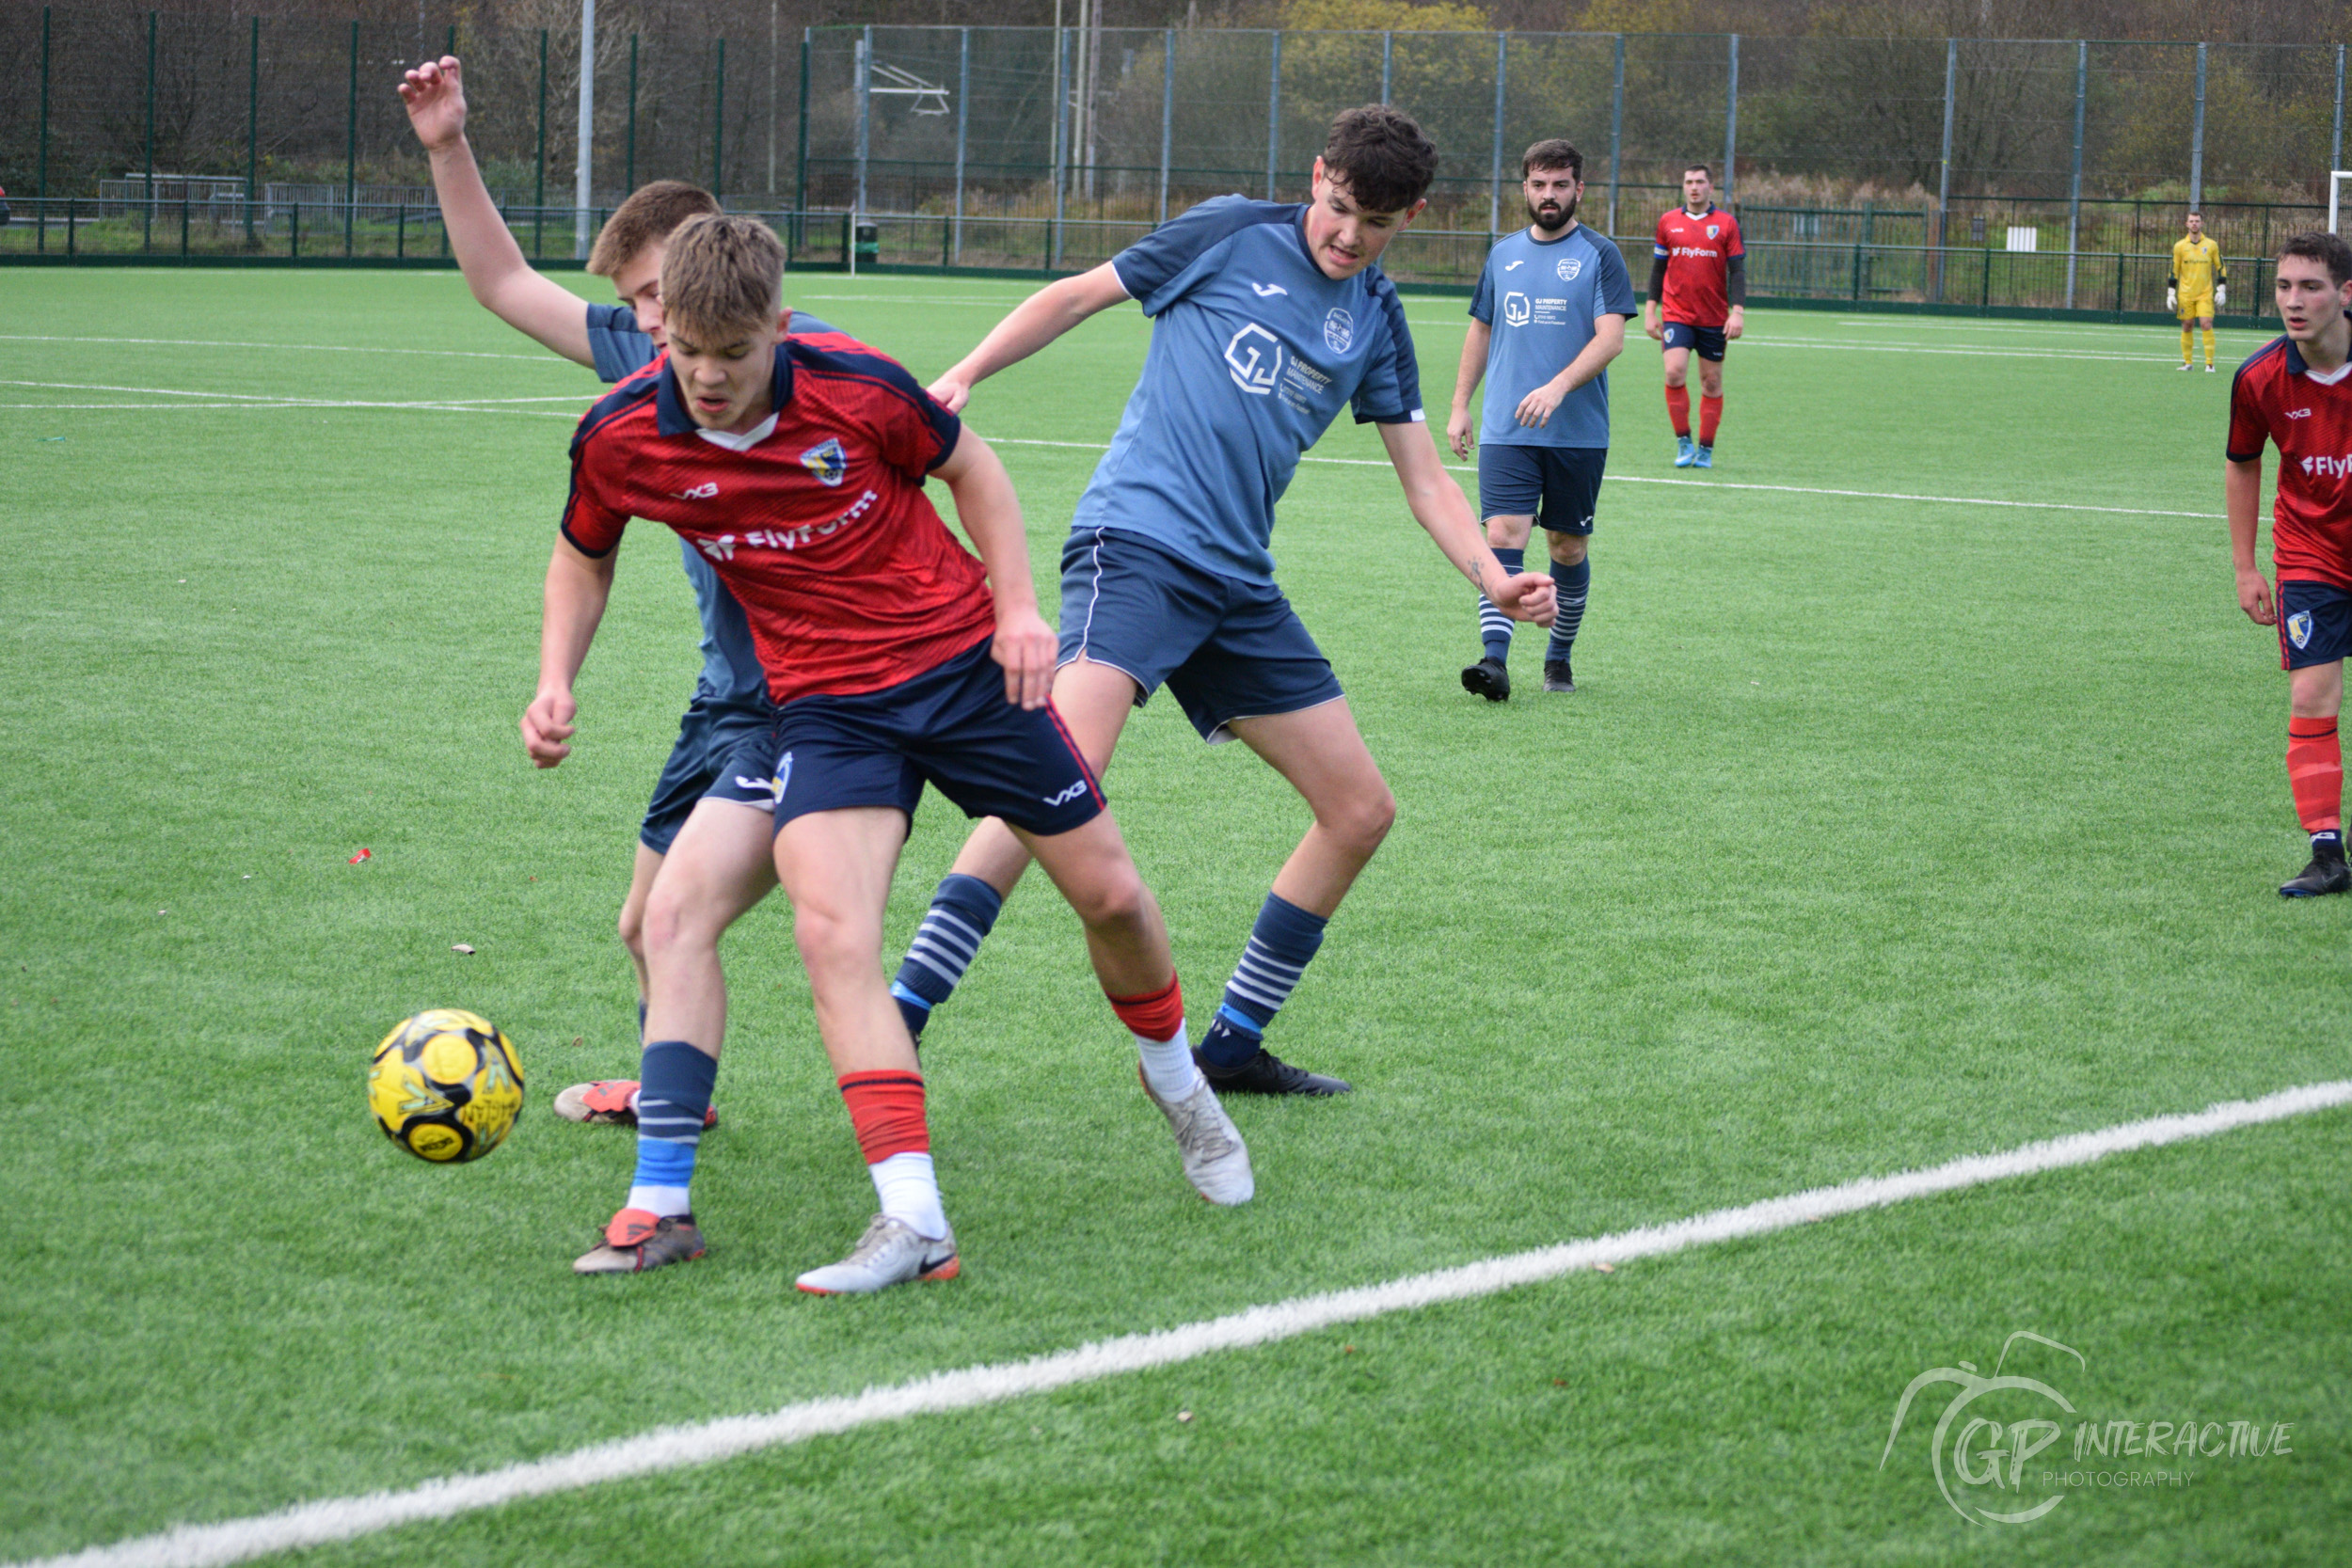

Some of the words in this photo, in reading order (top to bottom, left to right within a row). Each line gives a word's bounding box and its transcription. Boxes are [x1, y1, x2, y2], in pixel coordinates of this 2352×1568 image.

[1681, 247, 1718, 259] FlyForm
[1286, 367, 1325, 395] MAINTENANCE
[1297, 361, 1333, 385] PROPERTY
[2284, 407, 2312, 420] VX3
[669, 482, 719, 500] VX3
[1042, 779, 1088, 806] VX3
